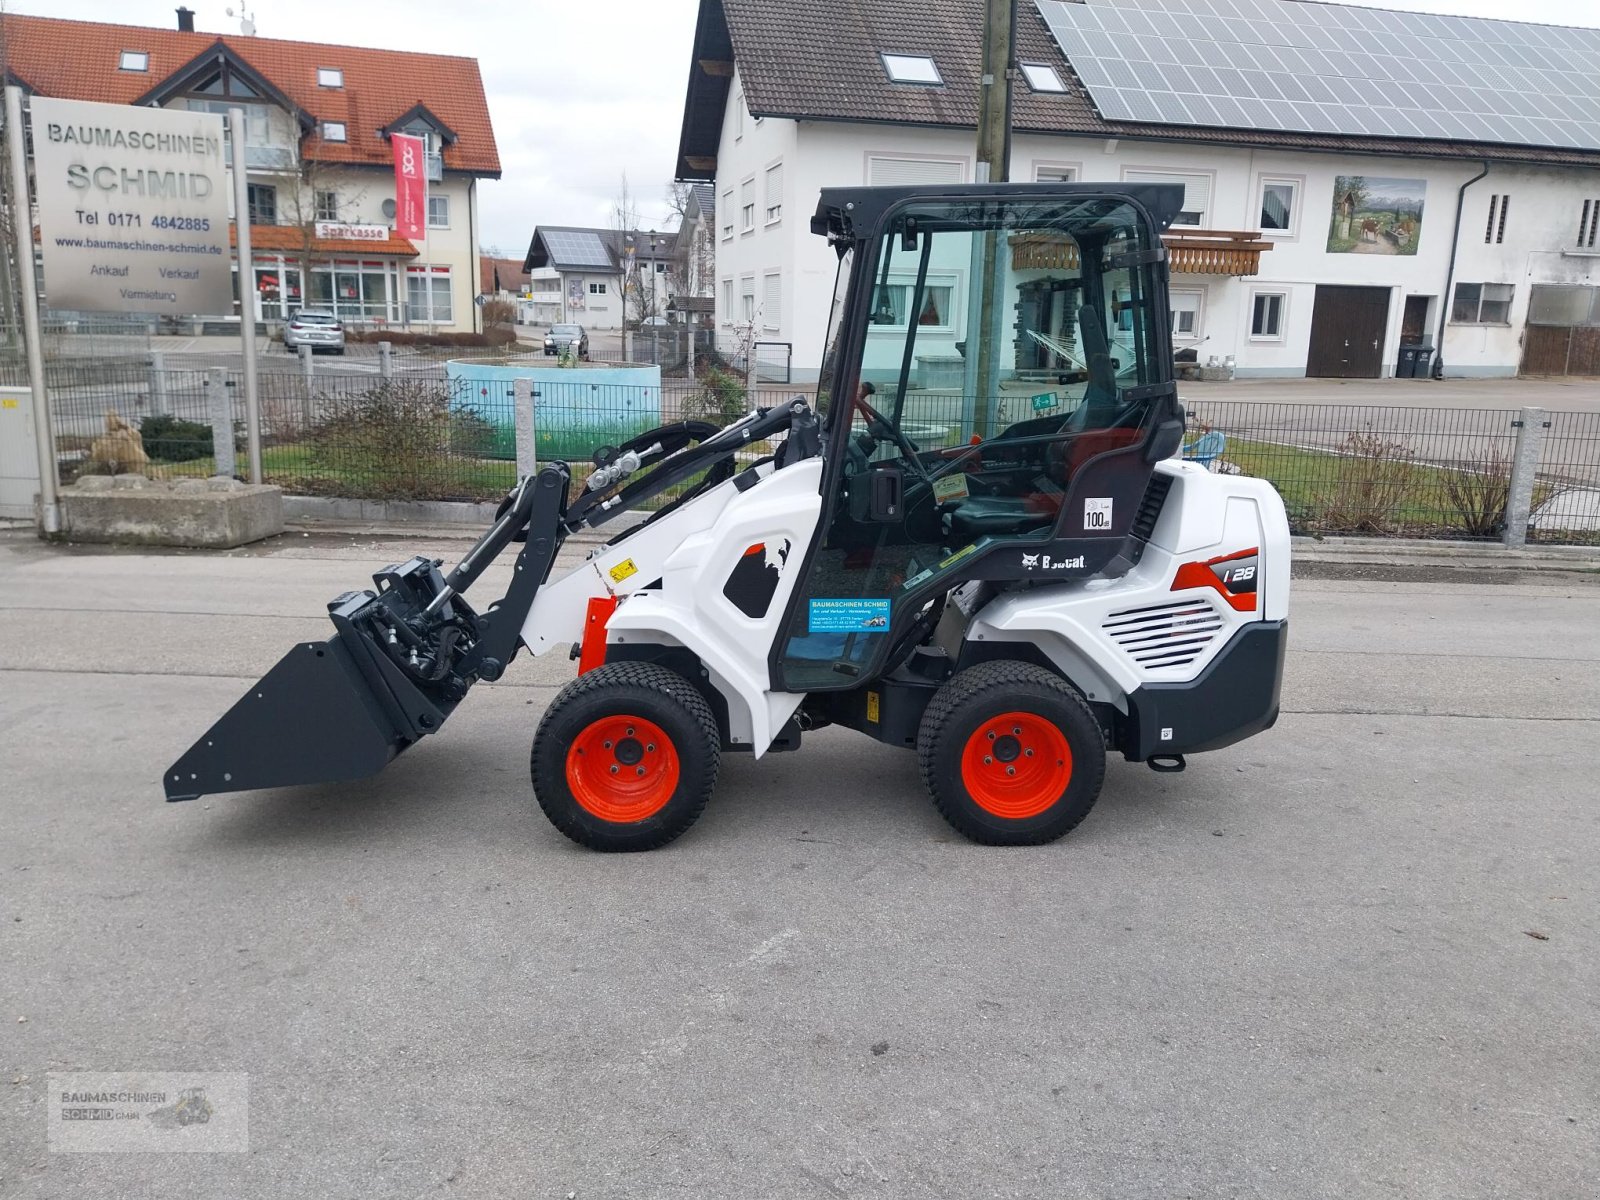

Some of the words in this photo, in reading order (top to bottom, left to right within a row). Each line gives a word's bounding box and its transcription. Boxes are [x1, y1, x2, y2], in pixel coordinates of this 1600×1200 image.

[48, 124, 220, 156] BAUMASCHINEN
[67, 164, 213, 199] SCHMID
[75, 210, 99, 225] Tel
[108, 212, 142, 228] 0171
[151, 215, 210, 232] 4842885
[322, 224, 383, 239] Sparkasse
[55, 237, 222, 255] www.baumaschinen-schmid.de
[90, 264, 130, 277] Ankauf
[158, 267, 200, 280] Verkauf
[120, 288, 177, 302] Vermietung
[1086, 511, 1104, 528] 100
